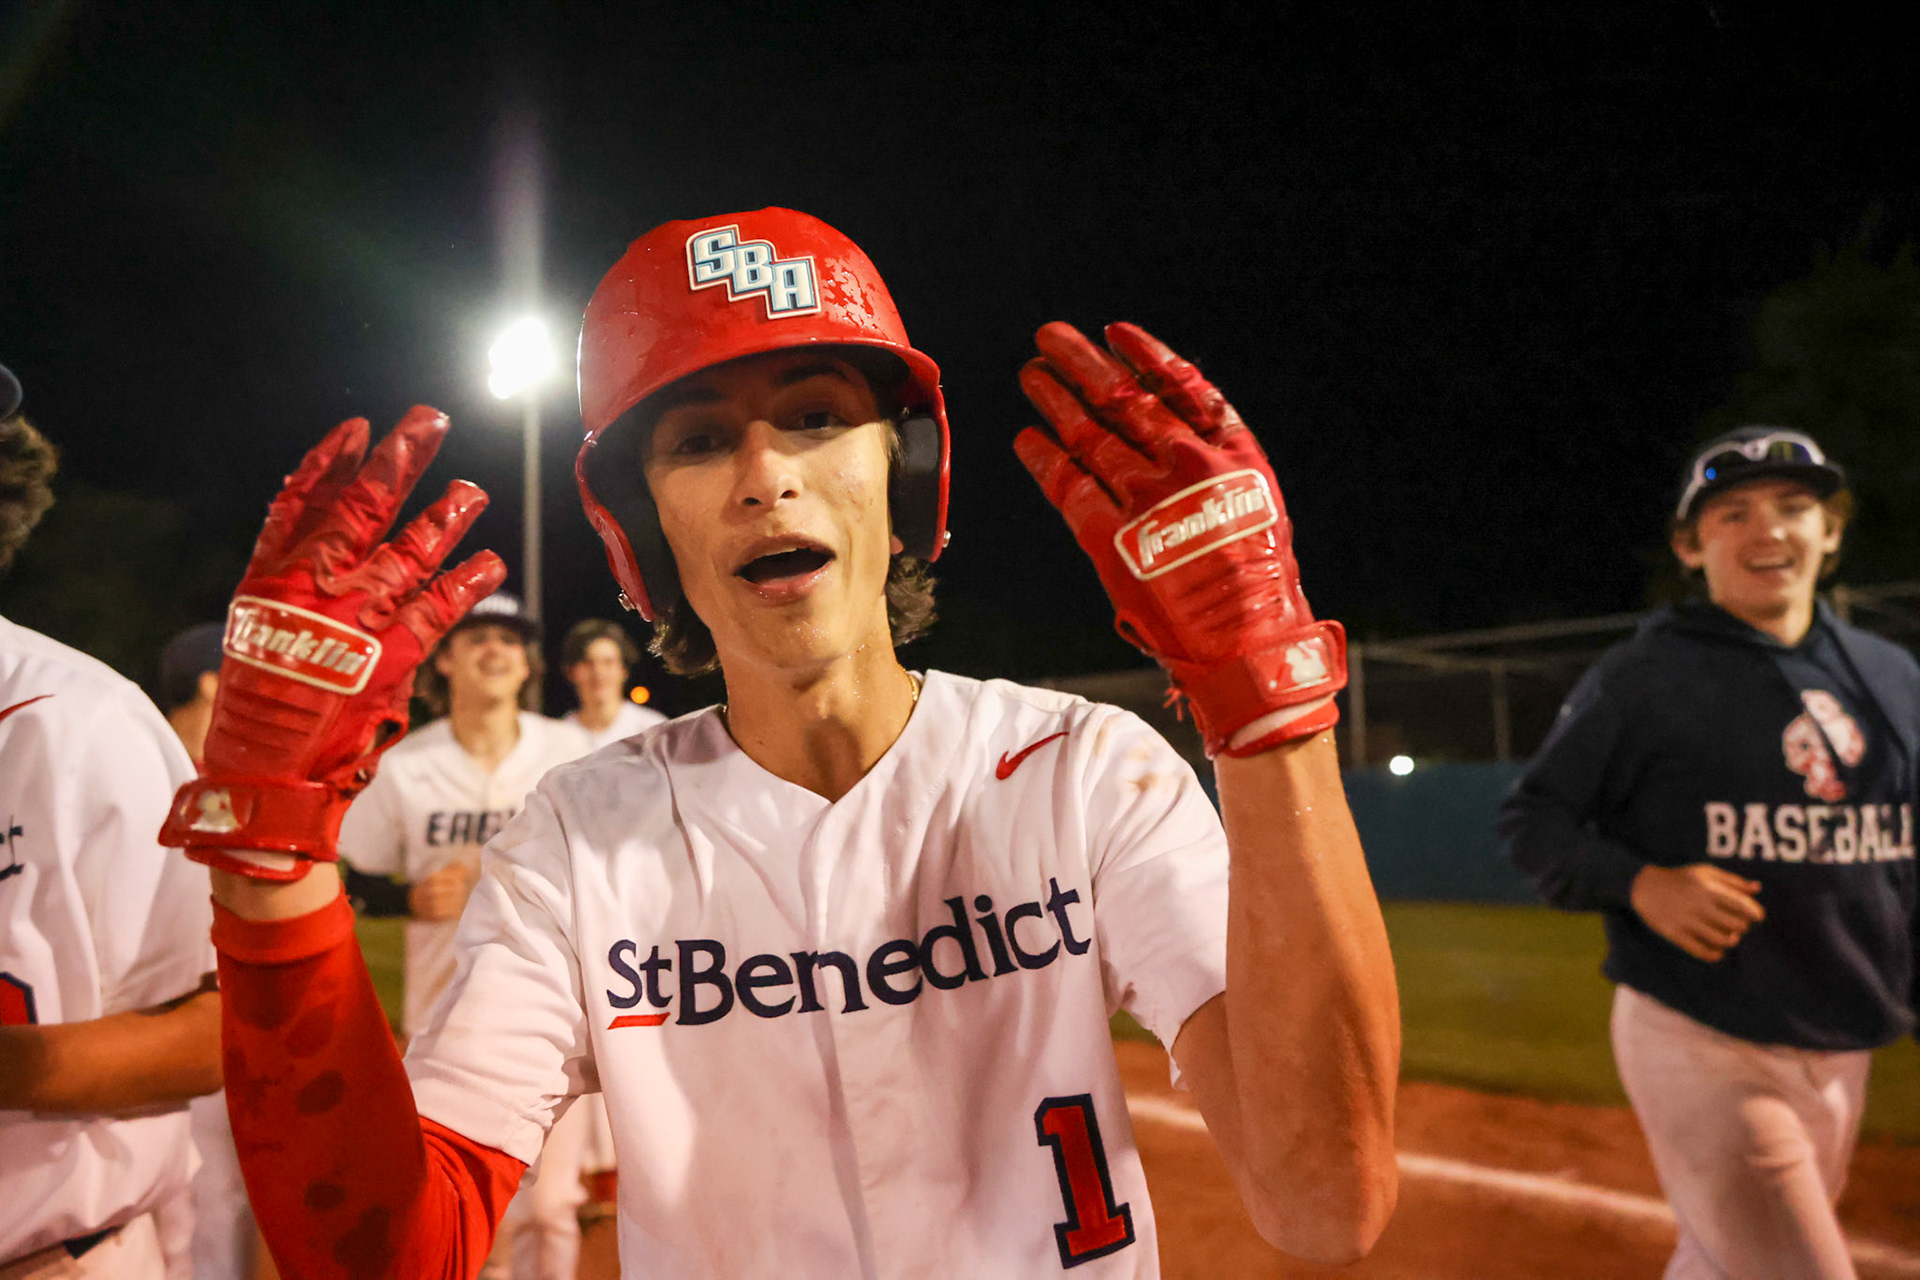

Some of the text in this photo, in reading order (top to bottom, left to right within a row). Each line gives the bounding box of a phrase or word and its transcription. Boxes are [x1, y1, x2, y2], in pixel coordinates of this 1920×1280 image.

[691, 227, 818, 314] SBA
[1704, 802, 1915, 865] BASEBALL
[1034, 1093, 1136, 1269] 1
